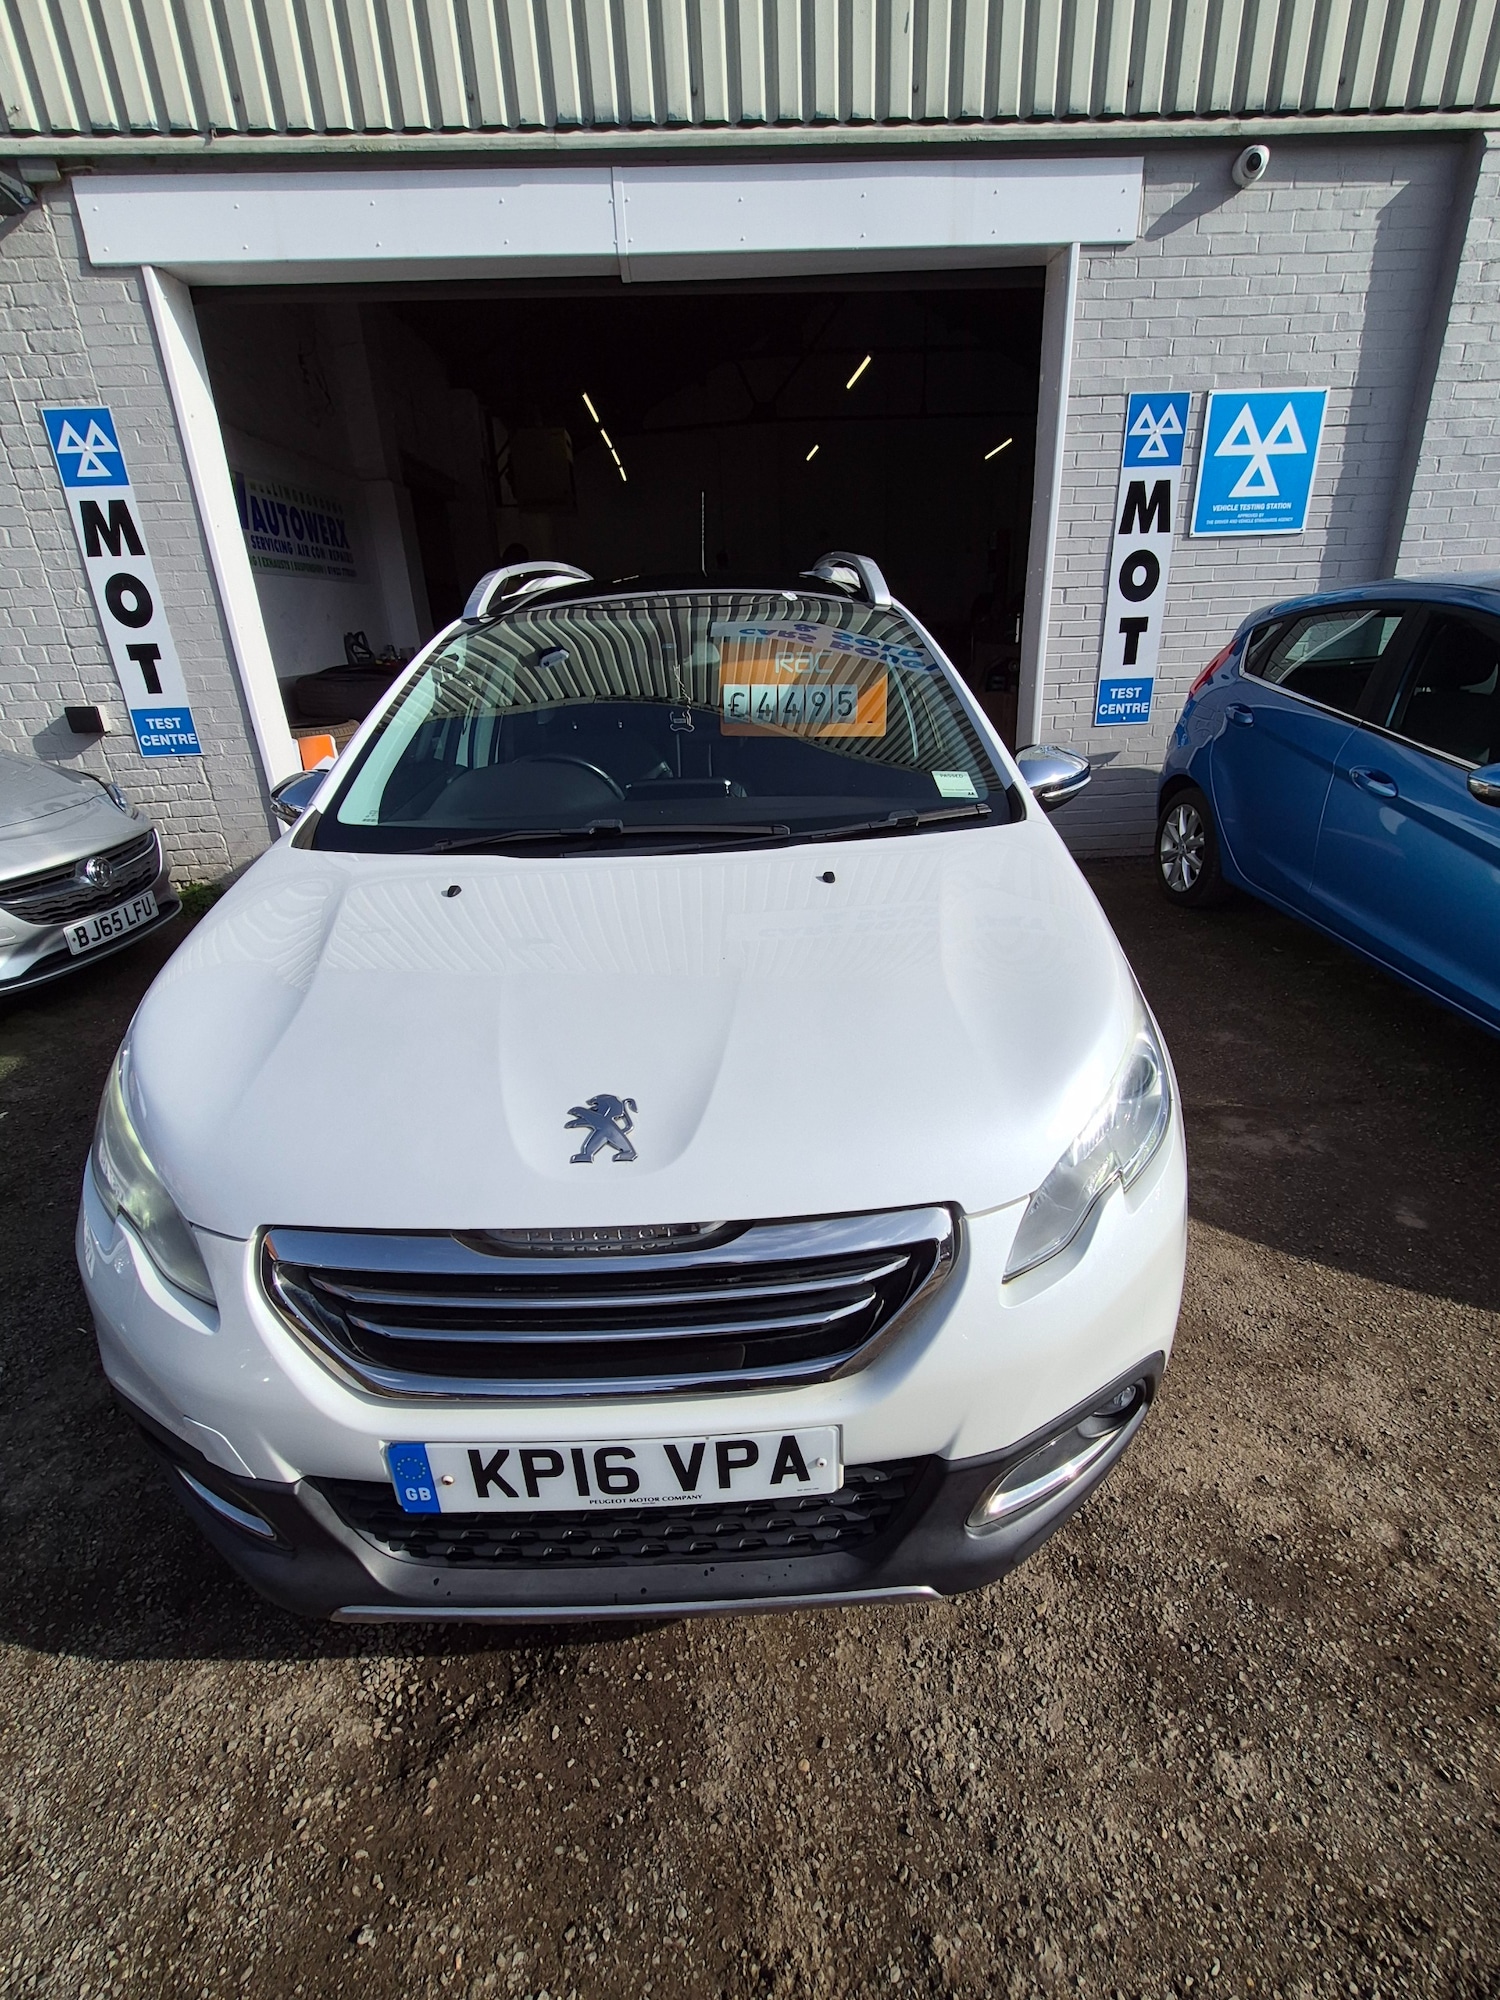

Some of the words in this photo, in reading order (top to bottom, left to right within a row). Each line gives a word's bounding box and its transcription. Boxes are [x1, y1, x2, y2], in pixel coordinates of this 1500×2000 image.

[1212, 504, 1239, 512] VEHICLE
[1240, 503, 1265, 511] TESTING
[1266, 502, 1292, 510] STATION
[250, 495, 350, 549] AUTOWERX
[251, 535, 293, 554] SERVICING
[297, 544, 310, 557] AIR
[312, 546, 325, 560] CON
[1118, 480, 1171, 665] MOT
[79, 500, 163, 694] MOT
[1110, 687, 1142, 699] TEST
[728, 690, 854, 718] £4495
[1099, 702, 1149, 714] CENTRE
[145, 717, 181, 730] TEST
[140, 733, 197, 747] CENTRE
[73, 912, 123, 948] BJ65
[123, 896, 153, 927] LFU
[526, 1225, 673, 1242] PEUGEOT
[467, 1446, 640, 1499] KP16
[663, 1435, 811, 1492] VPA
[405, 1486, 431, 1502] GB
[662, 1494, 703, 1502] COMPANY
